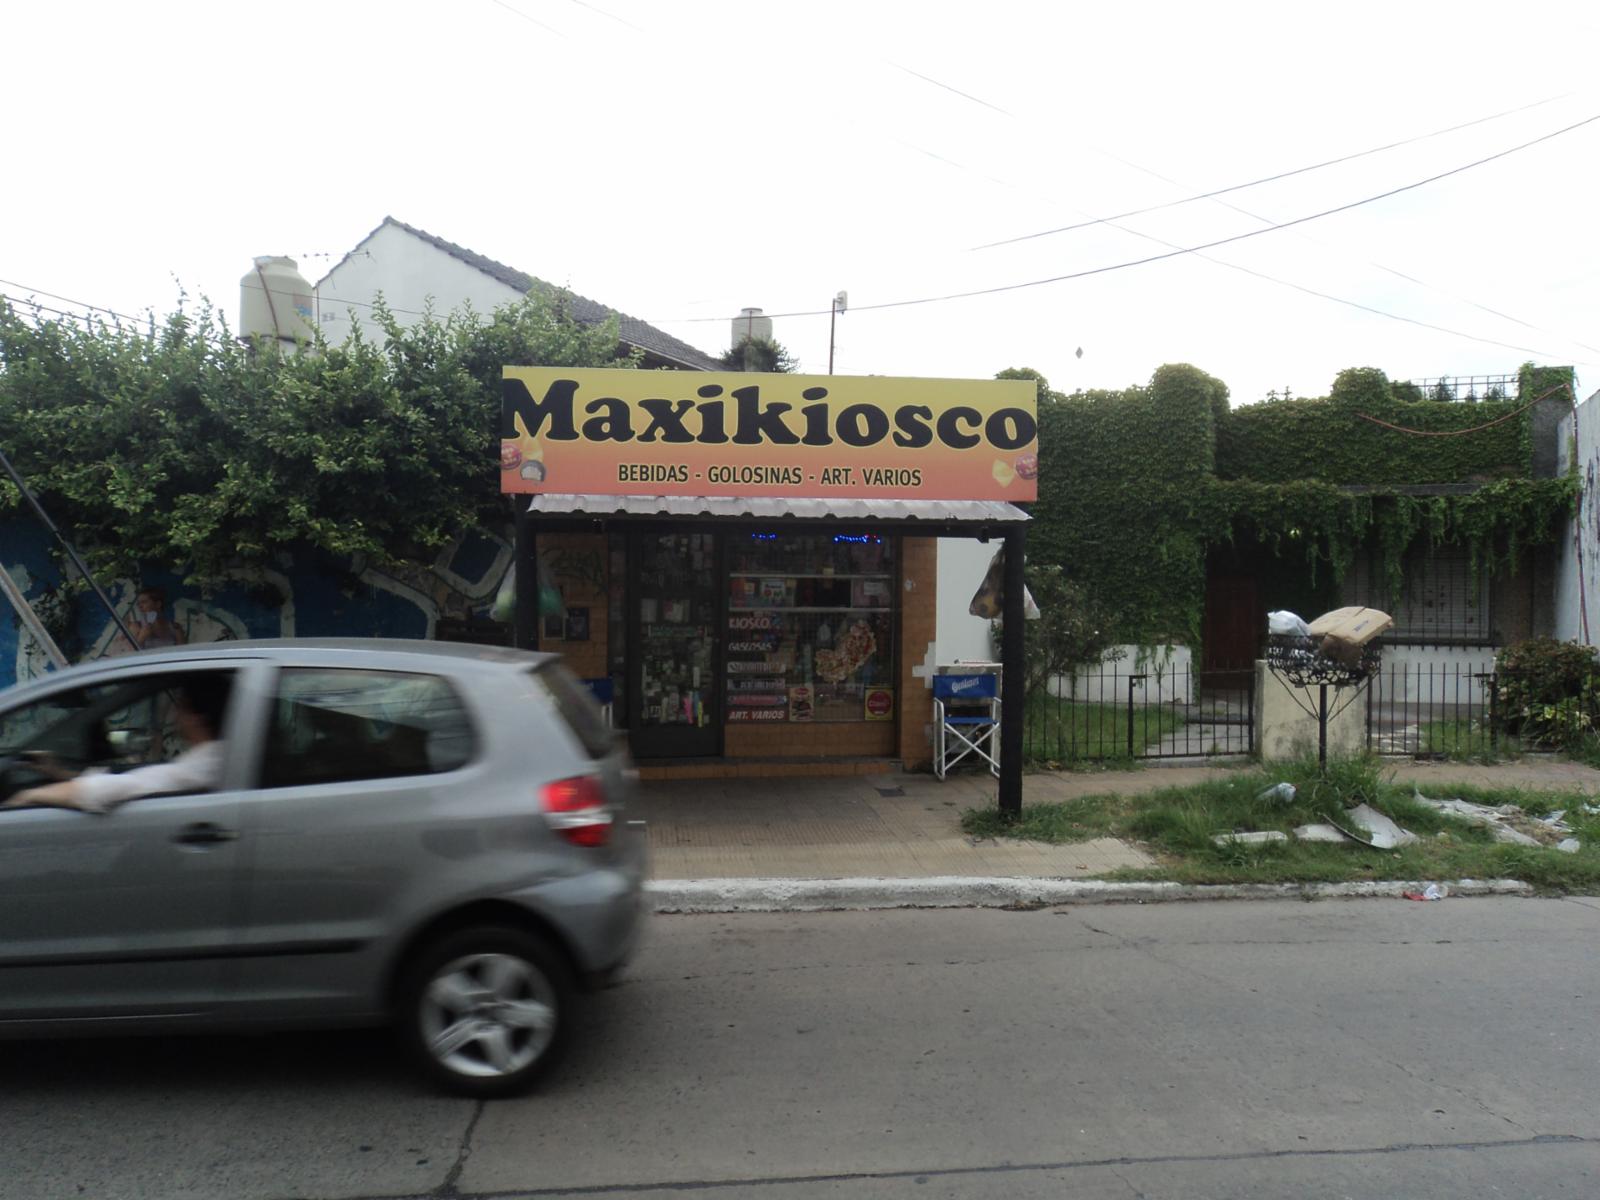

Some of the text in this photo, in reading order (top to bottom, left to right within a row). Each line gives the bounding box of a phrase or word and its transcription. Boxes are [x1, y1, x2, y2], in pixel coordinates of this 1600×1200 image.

[501, 378, 1037, 450] Maxikiosco
[618, 464, 689, 482] BEBIDAS
[708, 466, 802, 484] GOLOSINAS
[820, 468, 856, 485] ART.
[862, 468, 922, 486] VARIOS
[751, 710, 785, 720] VARIOS
